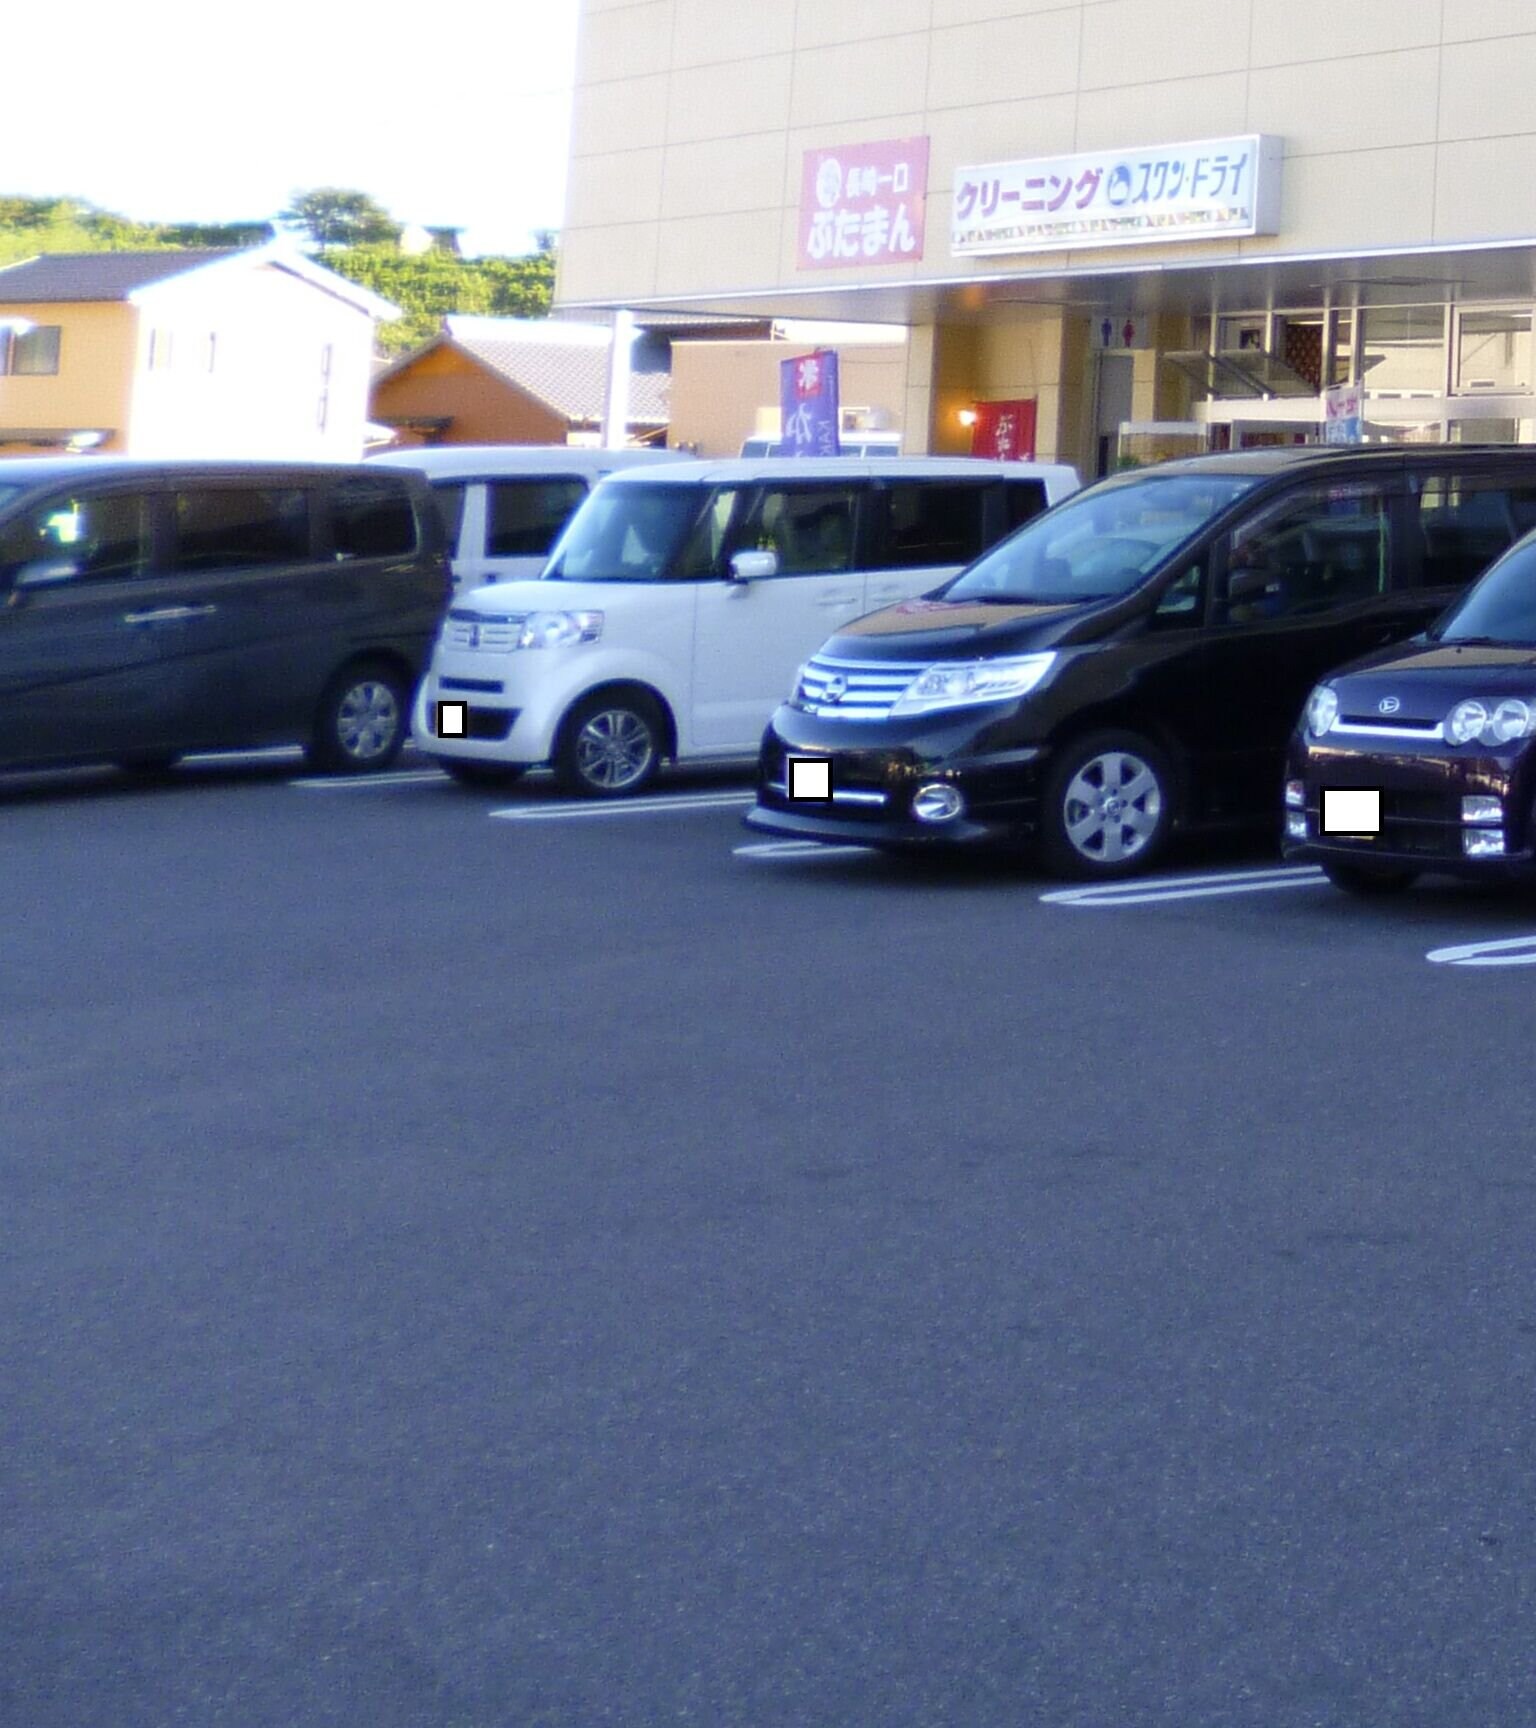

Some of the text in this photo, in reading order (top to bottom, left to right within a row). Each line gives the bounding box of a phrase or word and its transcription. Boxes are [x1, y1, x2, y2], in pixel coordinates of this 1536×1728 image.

[956, 168, 1104, 221] クリーニング
[806, 203, 916, 259] ぶたまん
